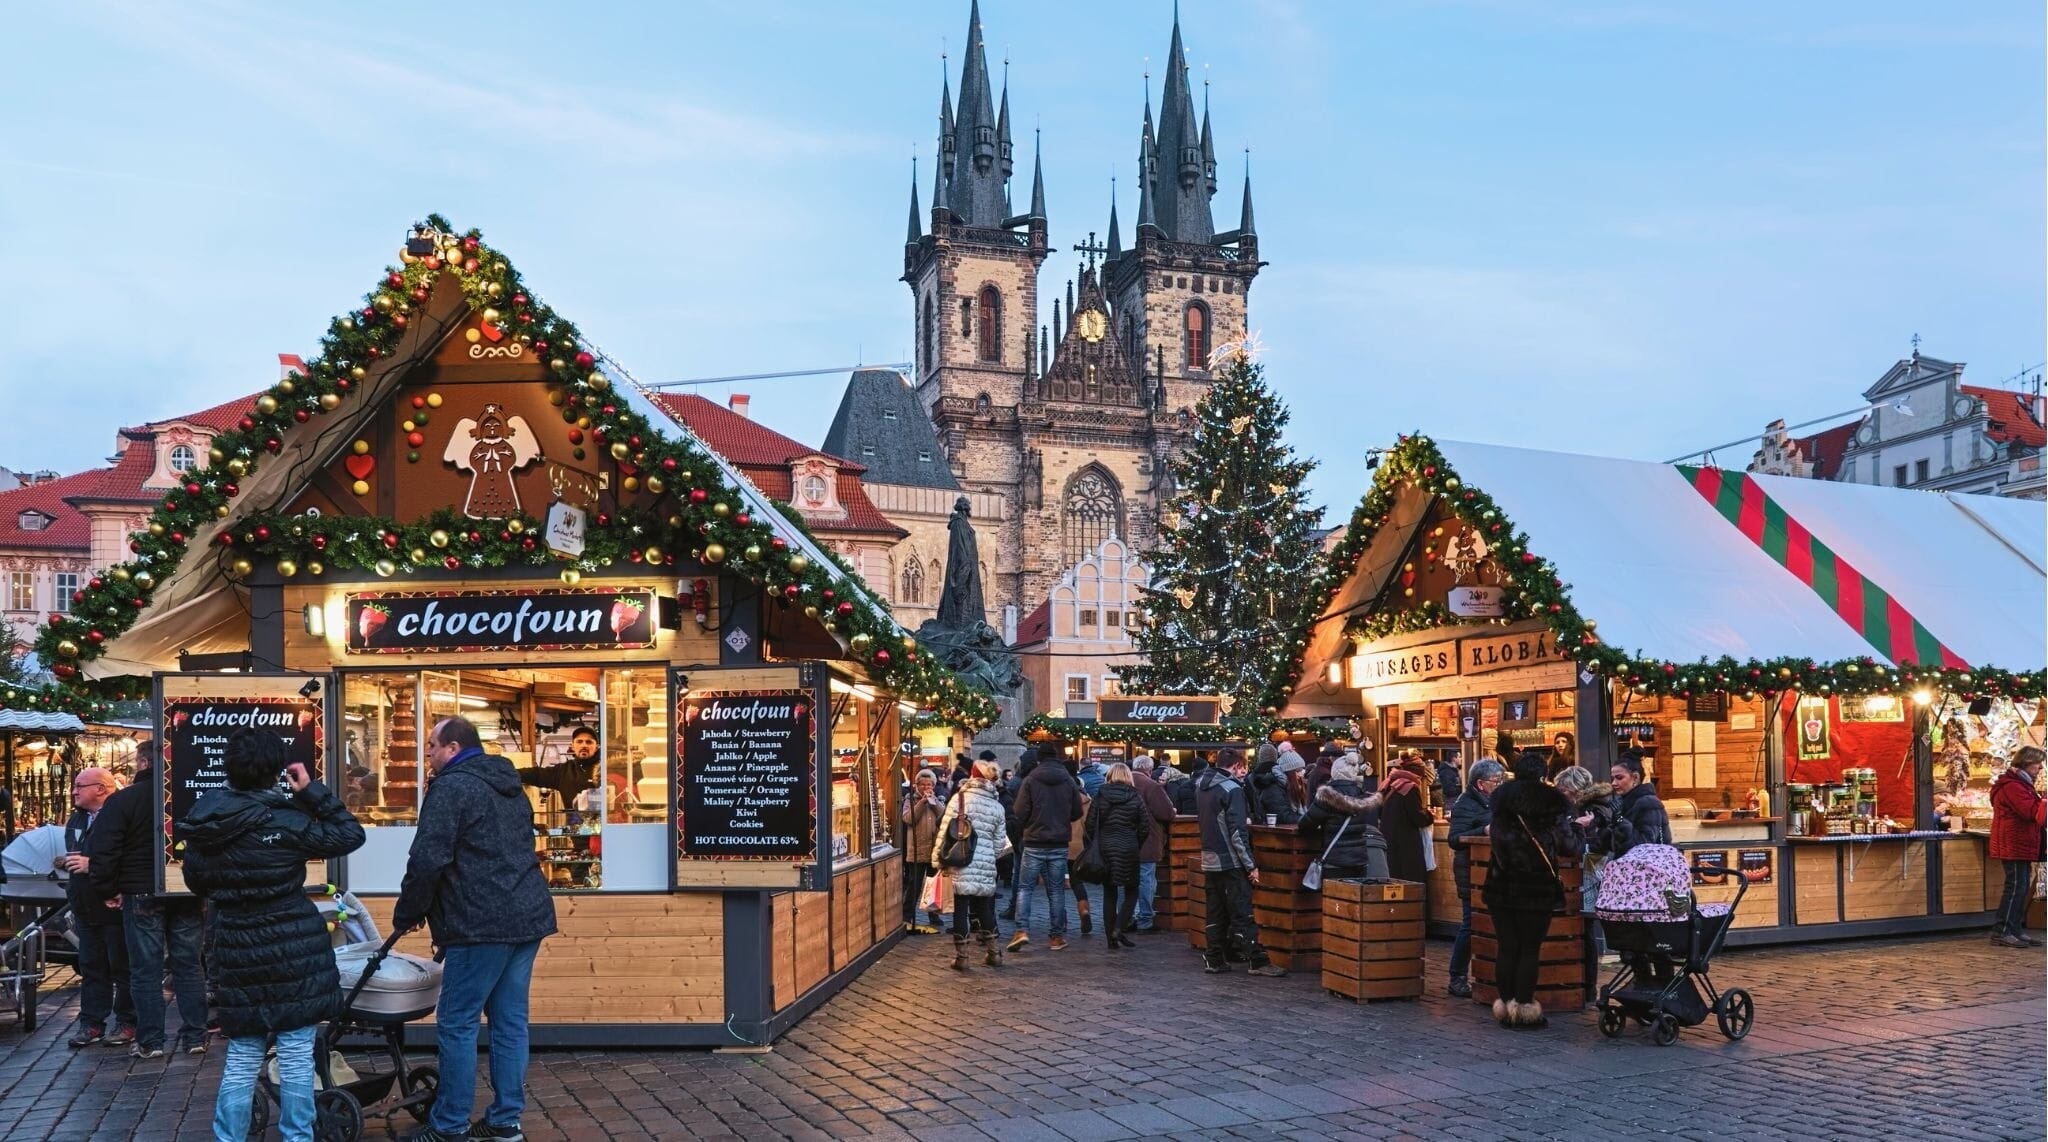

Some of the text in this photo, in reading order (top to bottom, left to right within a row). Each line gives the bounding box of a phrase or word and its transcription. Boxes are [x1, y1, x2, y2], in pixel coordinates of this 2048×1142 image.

[397, 599, 602, 642] chocofoun
[1357, 634, 1558, 679] AUSAGES KLOBÁ
[701, 700, 790, 724] chocofoun
[1128, 701, 1187, 722] Langoš
[192, 706, 294, 729] chocofoun
[701, 730, 732, 740] Jahoda
[741, 729, 791, 739] Strawberry
[191, 735, 228, 745] Jahoda
[711, 740, 739, 749] Banán
[749, 740, 782, 748] Banana
[203, 746, 225, 754] Ban
[714, 752, 743, 762] Jablko
[752, 752, 777, 761] Apple
[704, 763, 736, 772] Ananas
[746, 763, 789, 773] Pineapple
[185, 779, 223, 788] Hrozno
[695, 774, 736, 783] Hroznové
[738, 775, 757, 783] víno
[766, 774, 799, 784] Grapes
[704, 786, 747, 794] Pomeranč
[757, 786, 789, 796] Orange
[703, 797, 734, 807] Maliny
[744, 797, 790, 807] Raspberry
[736, 808, 757, 817] Kiwi
[729, 820, 764, 828] Cookies
[695, 836, 799, 845] HOT CHOCOLATE 63%
